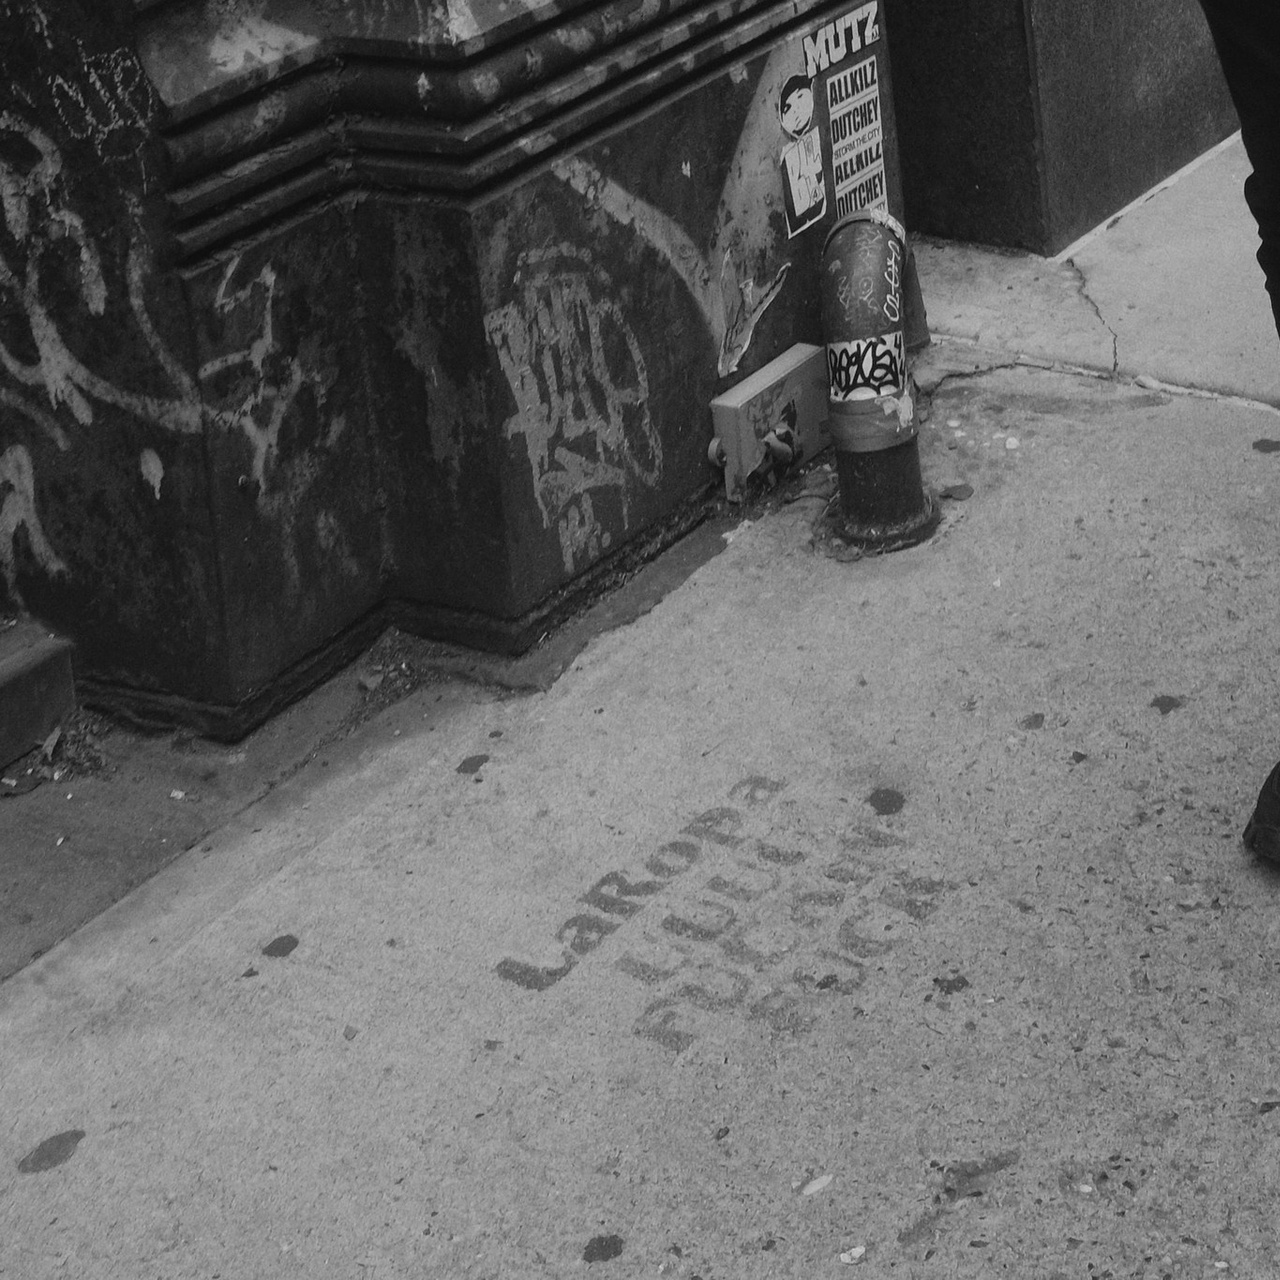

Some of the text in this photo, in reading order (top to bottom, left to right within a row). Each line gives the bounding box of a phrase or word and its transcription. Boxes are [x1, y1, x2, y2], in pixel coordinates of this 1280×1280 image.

[803, 0, 880, 79] MUTZ
[829, 60, 877, 108] ALLKILZ
[832, 96, 878, 144] DUTCHEY
[868, 126, 881, 141] CITY
